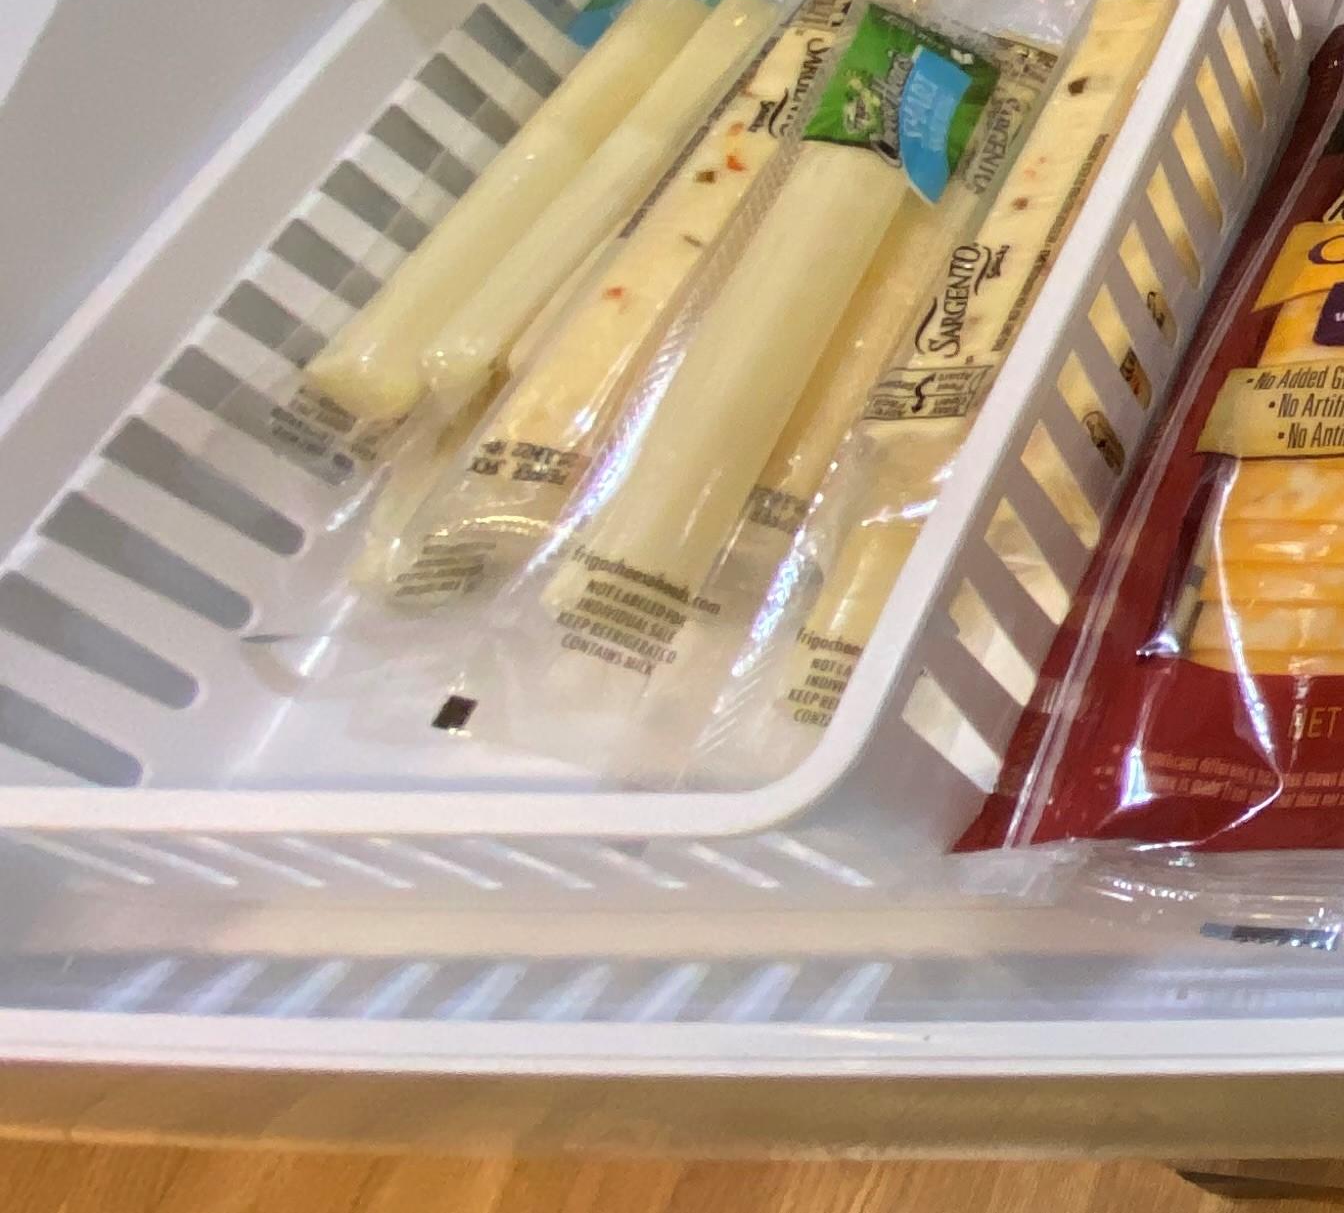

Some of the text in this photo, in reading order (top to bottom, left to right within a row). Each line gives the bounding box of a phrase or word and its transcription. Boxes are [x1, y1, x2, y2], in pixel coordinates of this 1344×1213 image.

[928, 242, 982, 359] SARGENTO
[1253, 370, 1274, 392] No
[1277, 369, 1327, 391] Added
[1277, 395, 1298, 420] No
[1286, 425, 1308, 451] No
